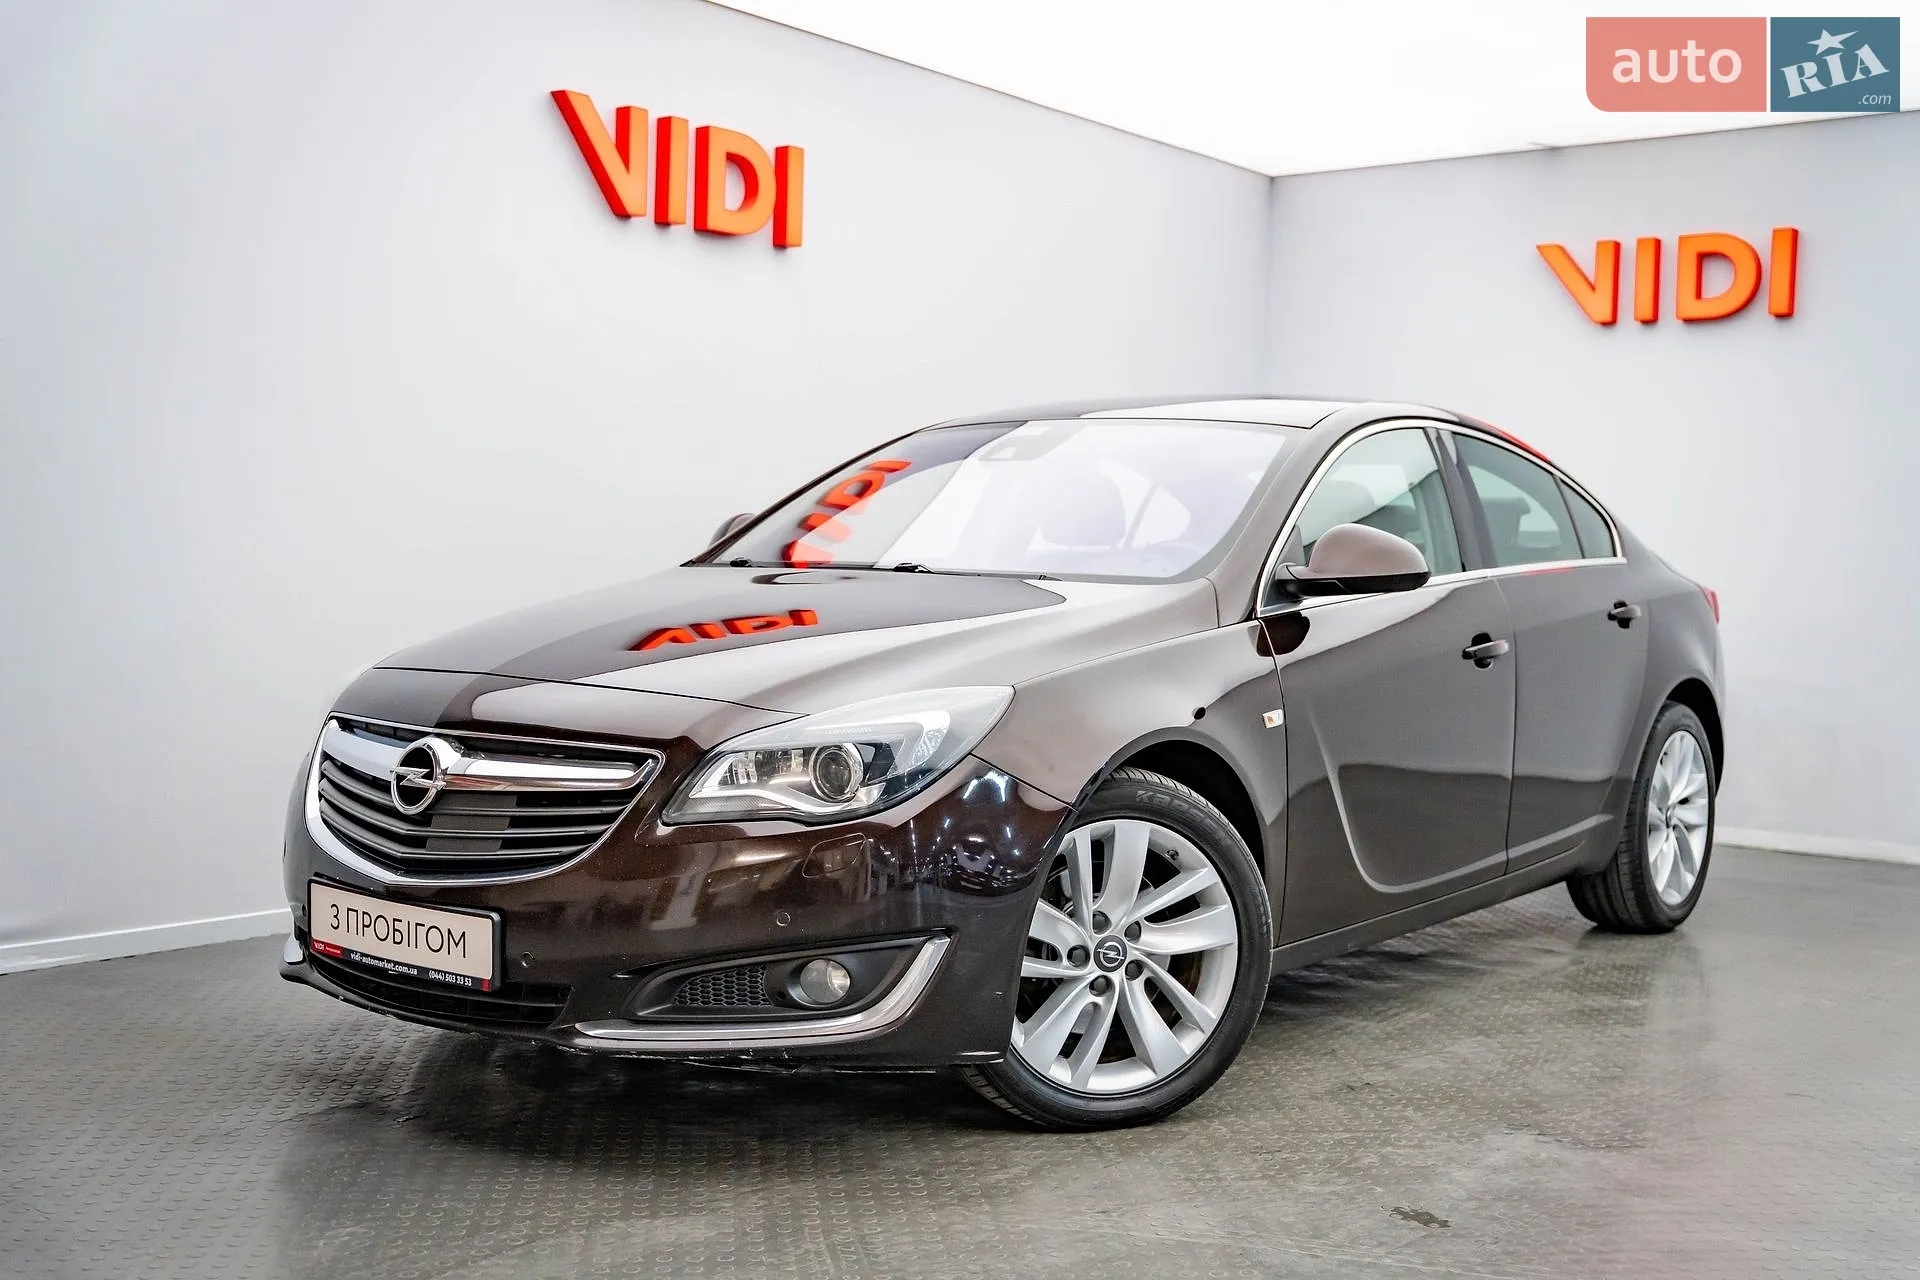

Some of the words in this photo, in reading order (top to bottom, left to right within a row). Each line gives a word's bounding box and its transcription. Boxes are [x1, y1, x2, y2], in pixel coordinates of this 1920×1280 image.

[550, 90, 804, 248] VIDI
[1536, 227, 1799, 326] VIDI
[330, 903, 340, 930] З
[346, 908, 466, 958] ПРОБІГОМ
[350, 951, 418, 975] vidi-automarket.com.ua
[428, 970, 445, 981] (044)
[445, 973, 456, 983] 503
[456, 975, 464, 985] 33
[464, 977, 472, 986] 53
